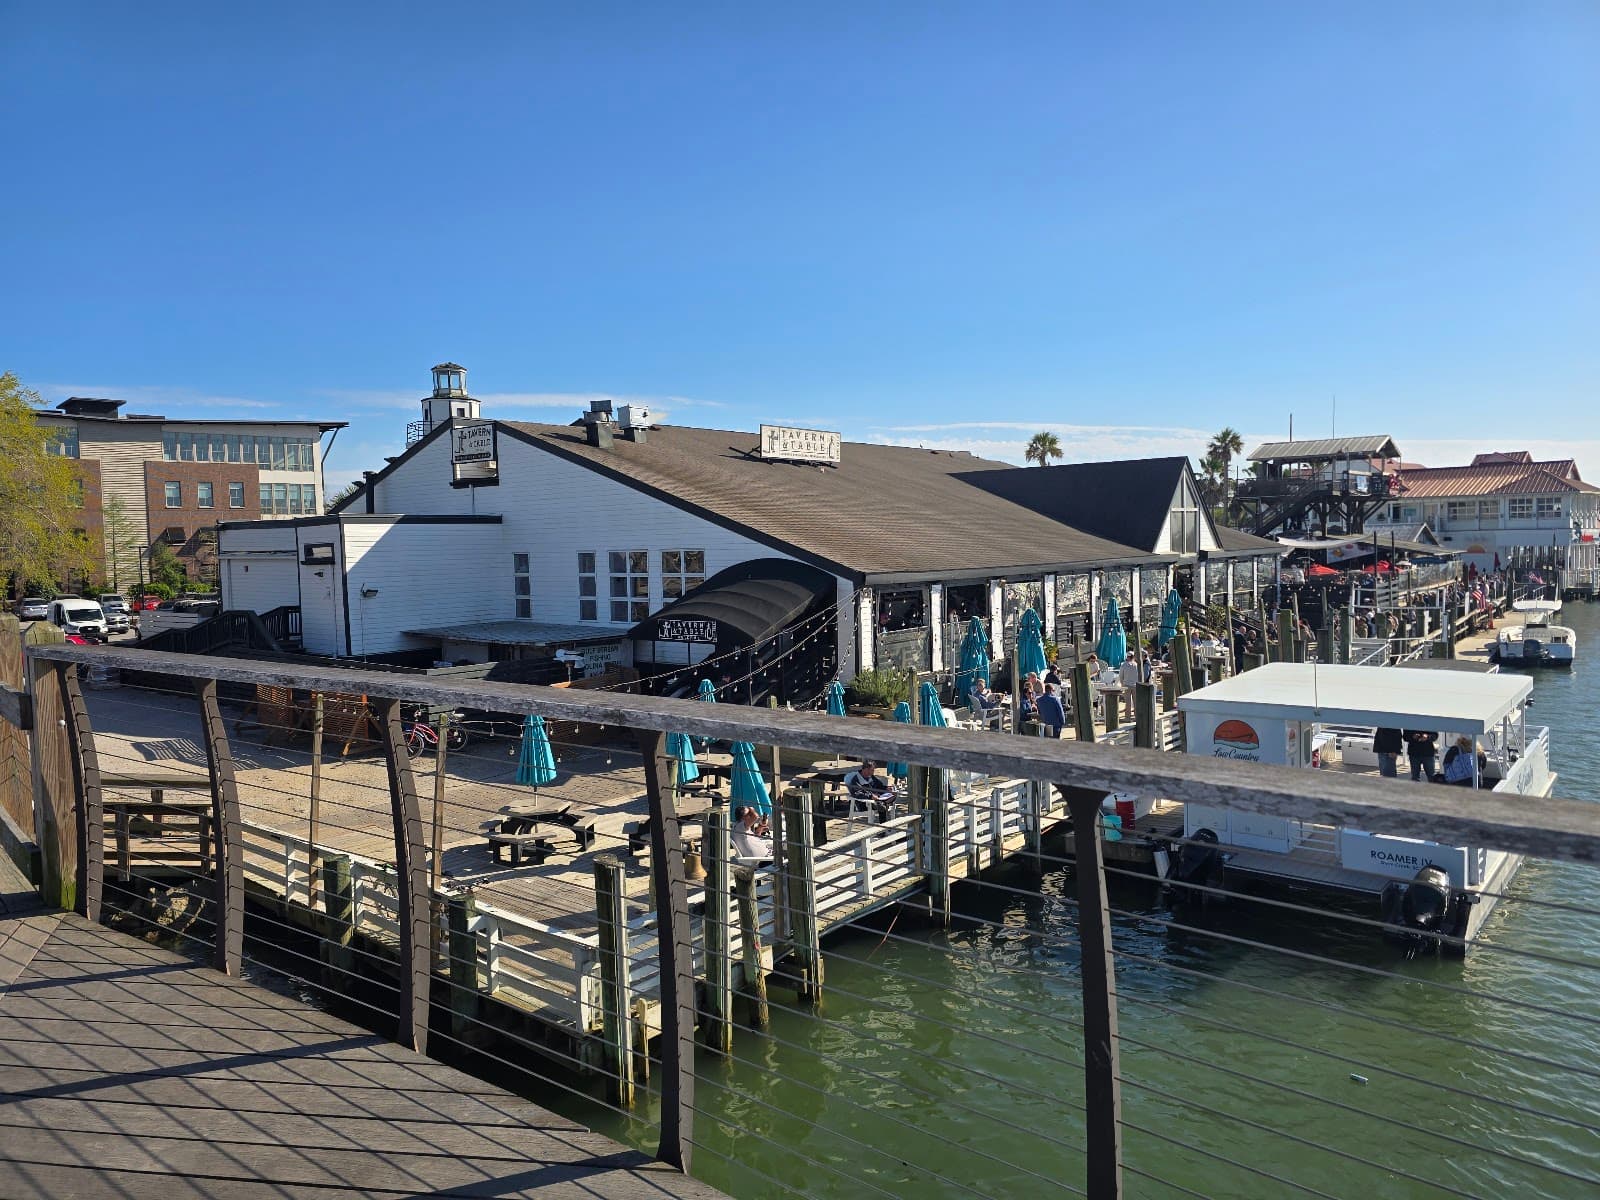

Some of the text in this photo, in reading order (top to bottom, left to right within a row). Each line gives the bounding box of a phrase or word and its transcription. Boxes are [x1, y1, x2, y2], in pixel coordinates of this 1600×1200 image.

[468, 427, 491, 439] TAVERN
[781, 430, 825, 442] TAVERN
[791, 440, 825, 452] TABLE
[672, 621, 704, 629] TAVERN
[678, 627, 704, 635] TABLE
[1228, 749, 1260, 762] Country
[1370, 850, 1418, 865] ROAMER
[1421, 858, 1433, 866] IV
